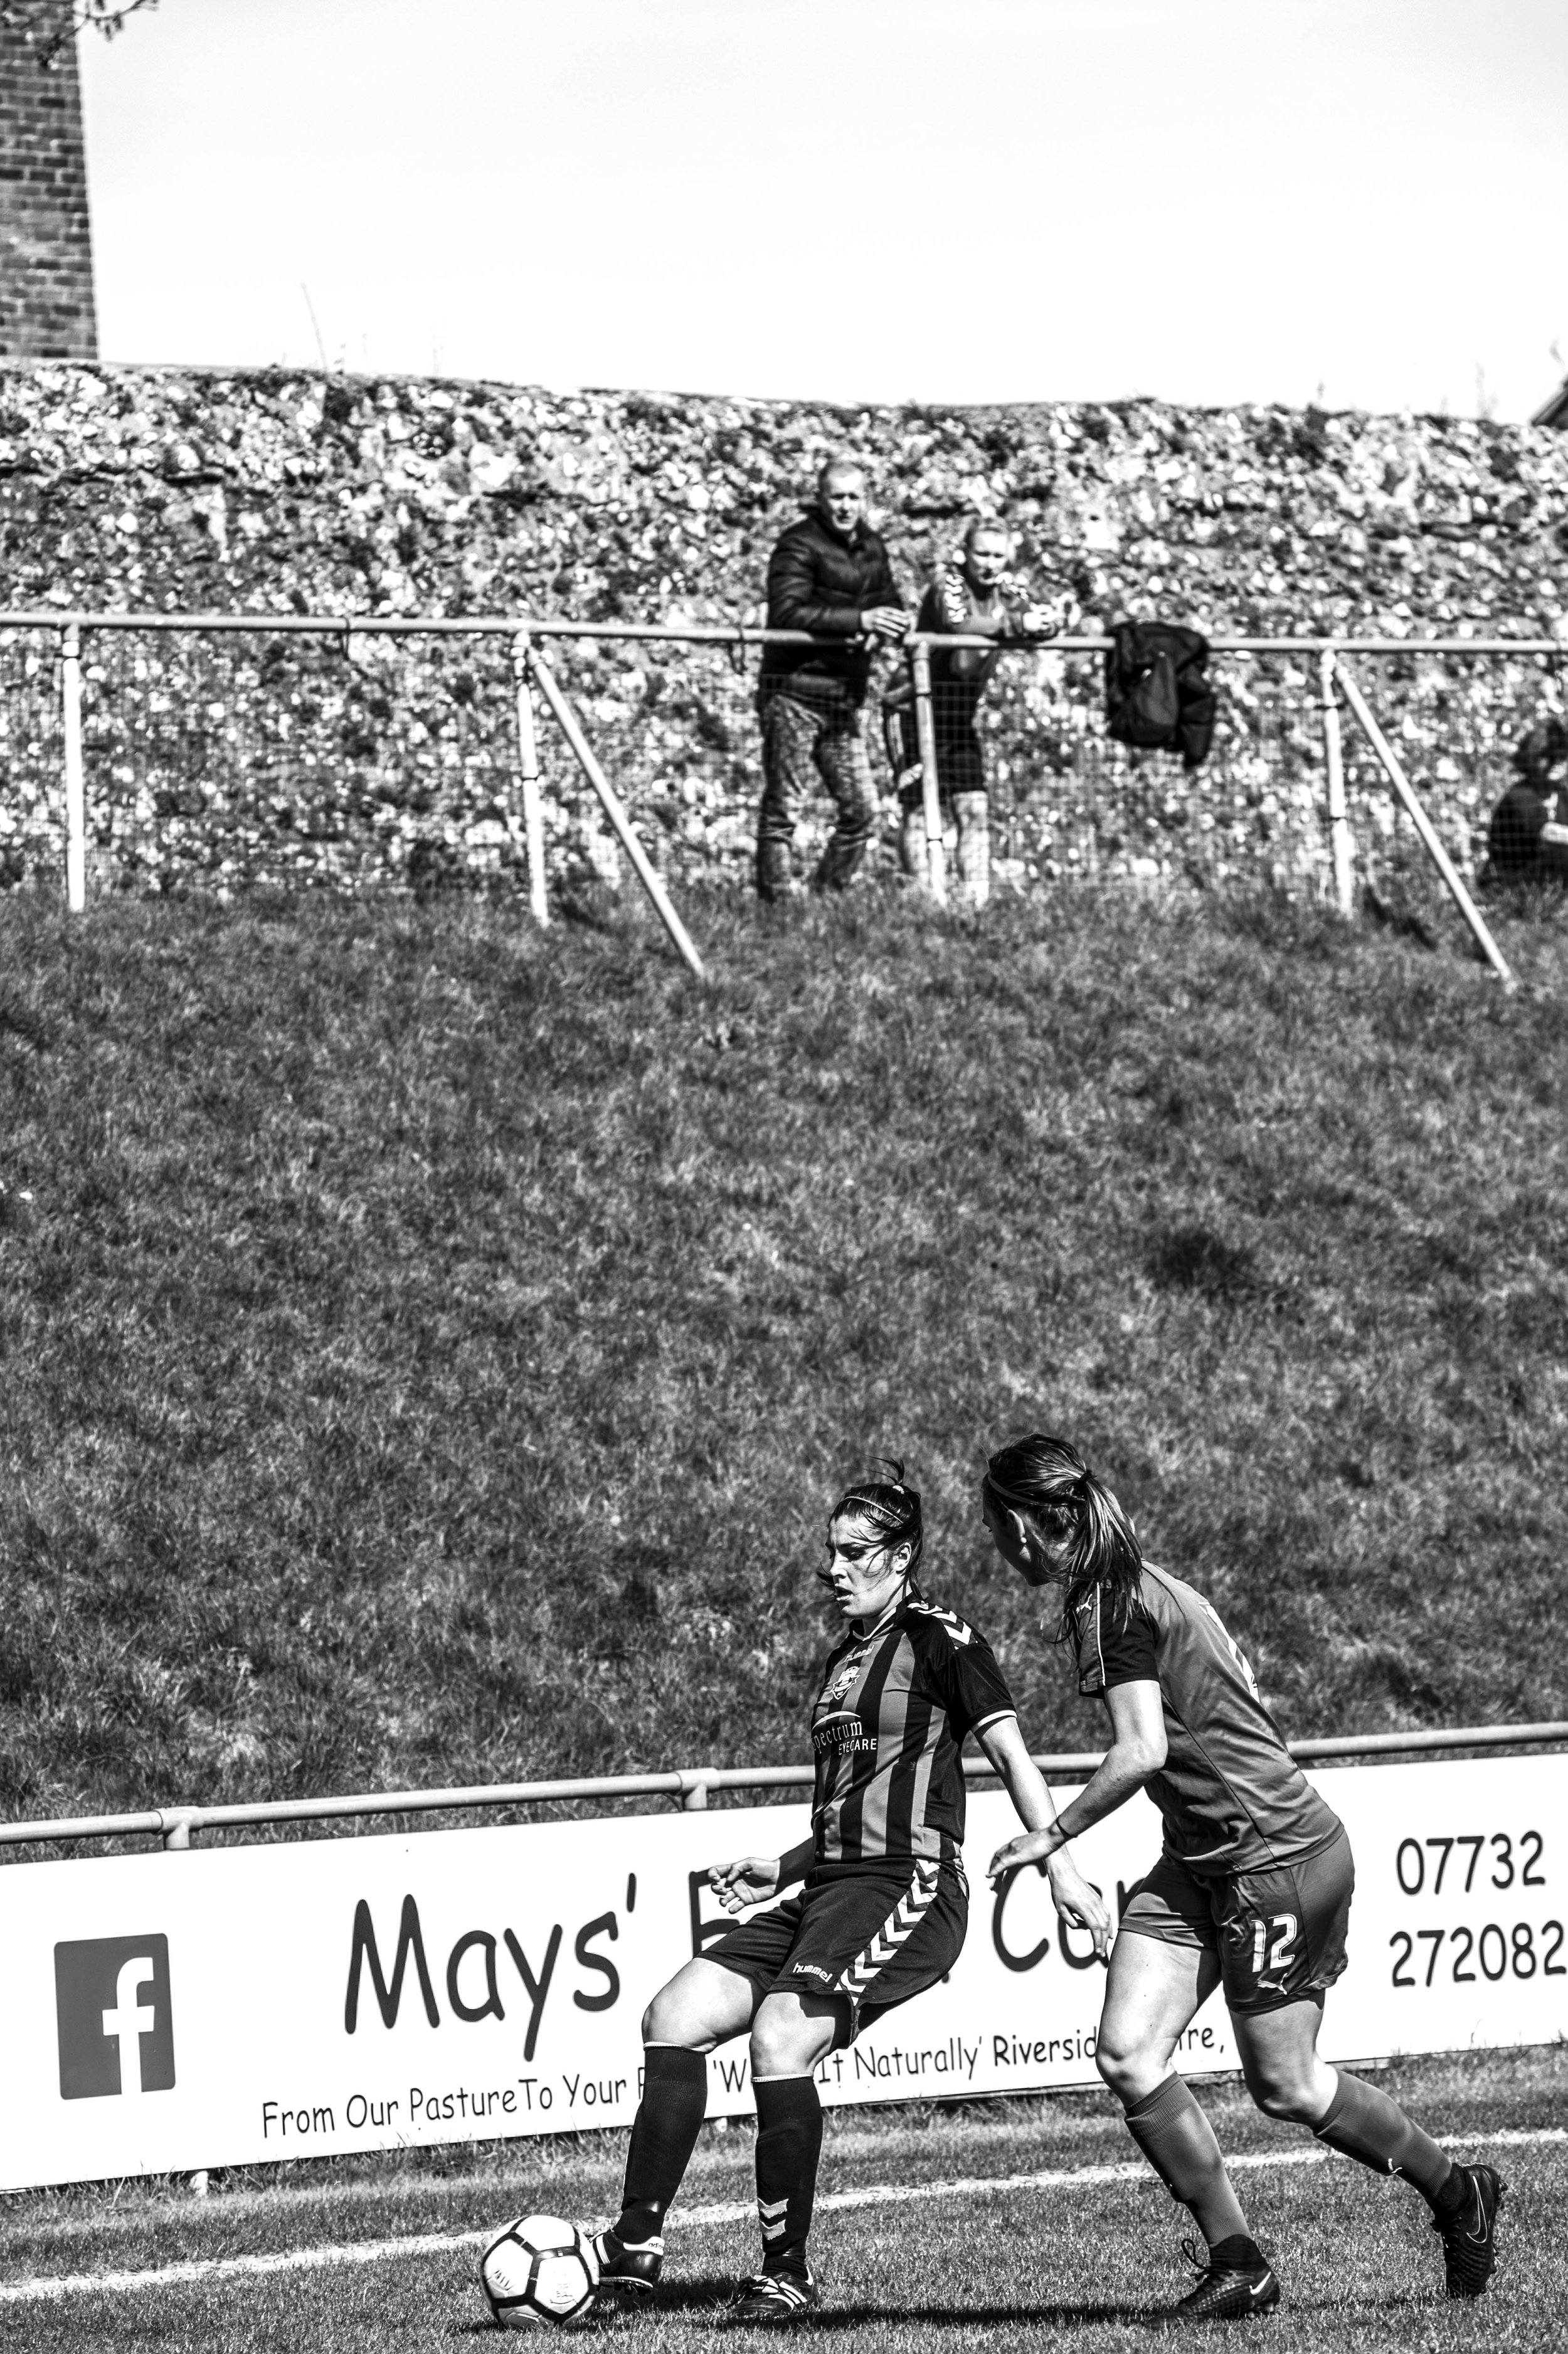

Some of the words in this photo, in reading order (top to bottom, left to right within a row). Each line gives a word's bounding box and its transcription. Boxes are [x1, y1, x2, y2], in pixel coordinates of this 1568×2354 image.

[812, 1721, 863, 1754] pectrum
[839, 1738, 877, 1755] EYECARE
[1396, 1830, 1546, 1895] 07732
[344, 1872, 637, 2062] Mays'
[792, 1962, 833, 1983] hummel
[1251, 1914, 1297, 1973] 12
[1389, 1920, 1567, 1988] 272082
[262, 2101, 335, 2138] From
[346, 2094, 400, 2128] Our
[562, 2074, 627, 2107] Your
[993, 2025, 1097, 2068] Riversid
